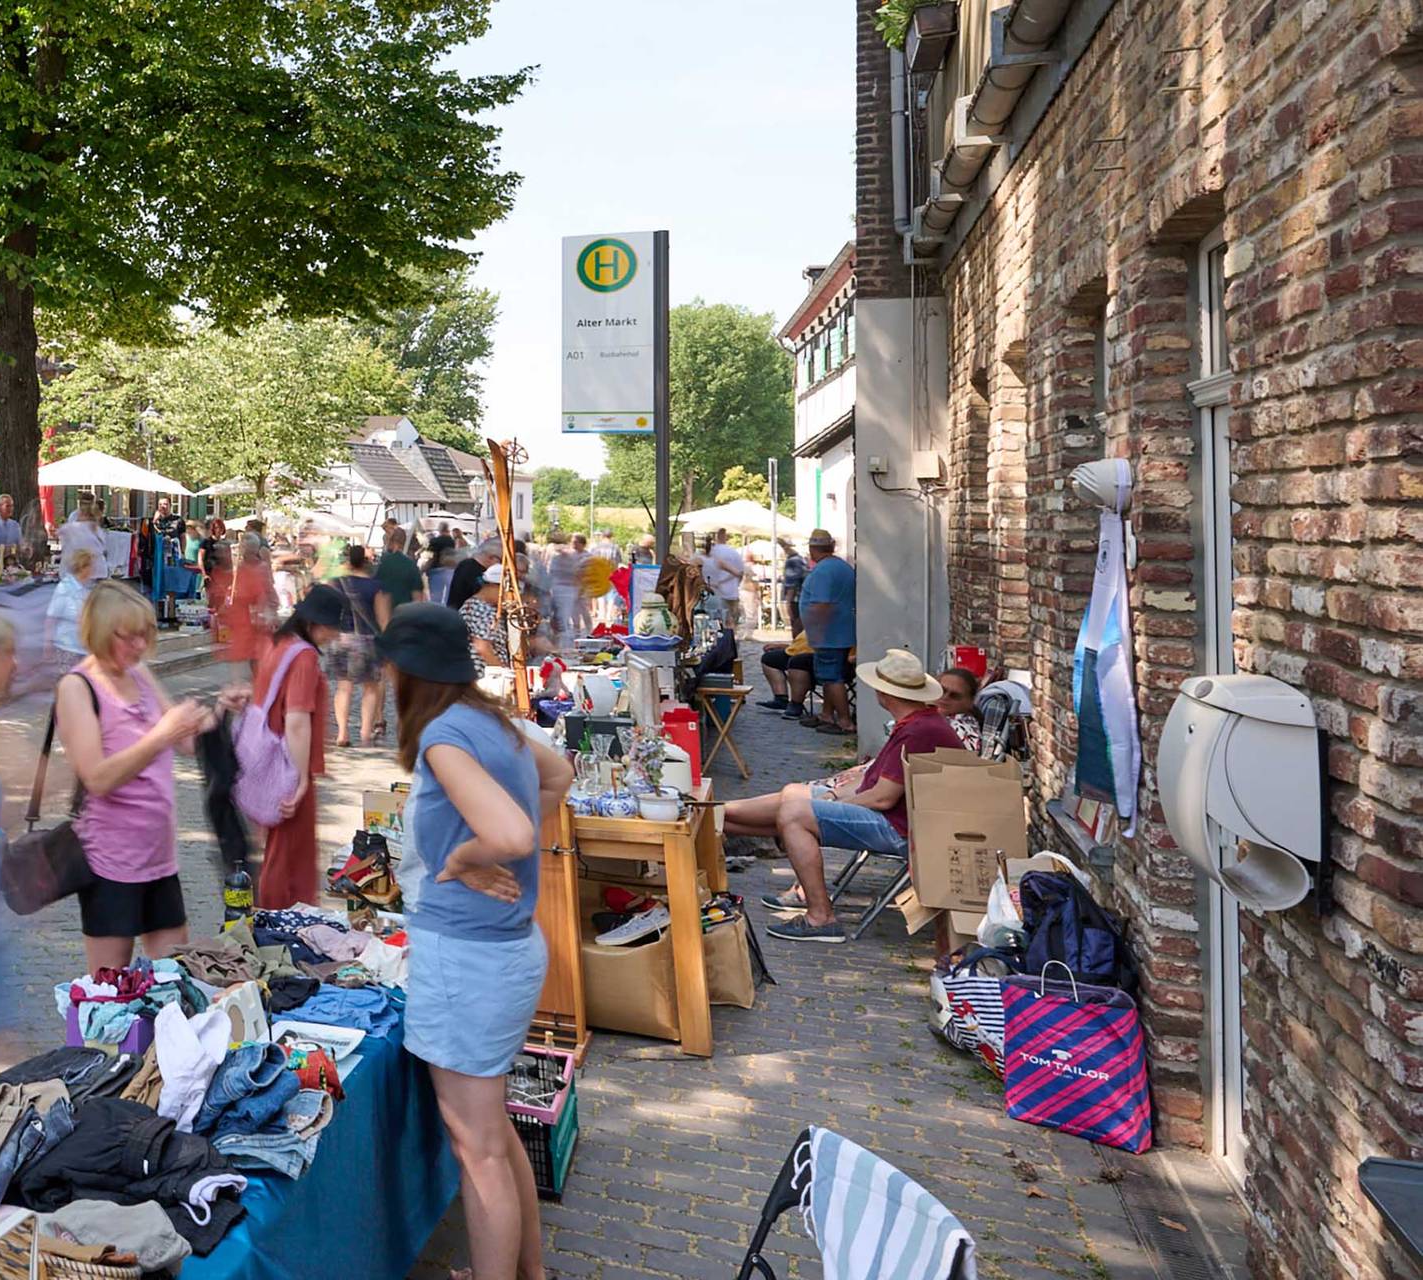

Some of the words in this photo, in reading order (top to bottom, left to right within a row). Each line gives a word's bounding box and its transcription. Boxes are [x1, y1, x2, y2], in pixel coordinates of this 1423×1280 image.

[594, 250, 619, 281] H
[576, 317, 602, 328] Alter
[605, 316, 638, 327] Markt
[566, 351, 584, 361] A01
[1020, 1052, 1051, 1068] TOM
[1052, 1061, 1110, 1081] TAILOR
